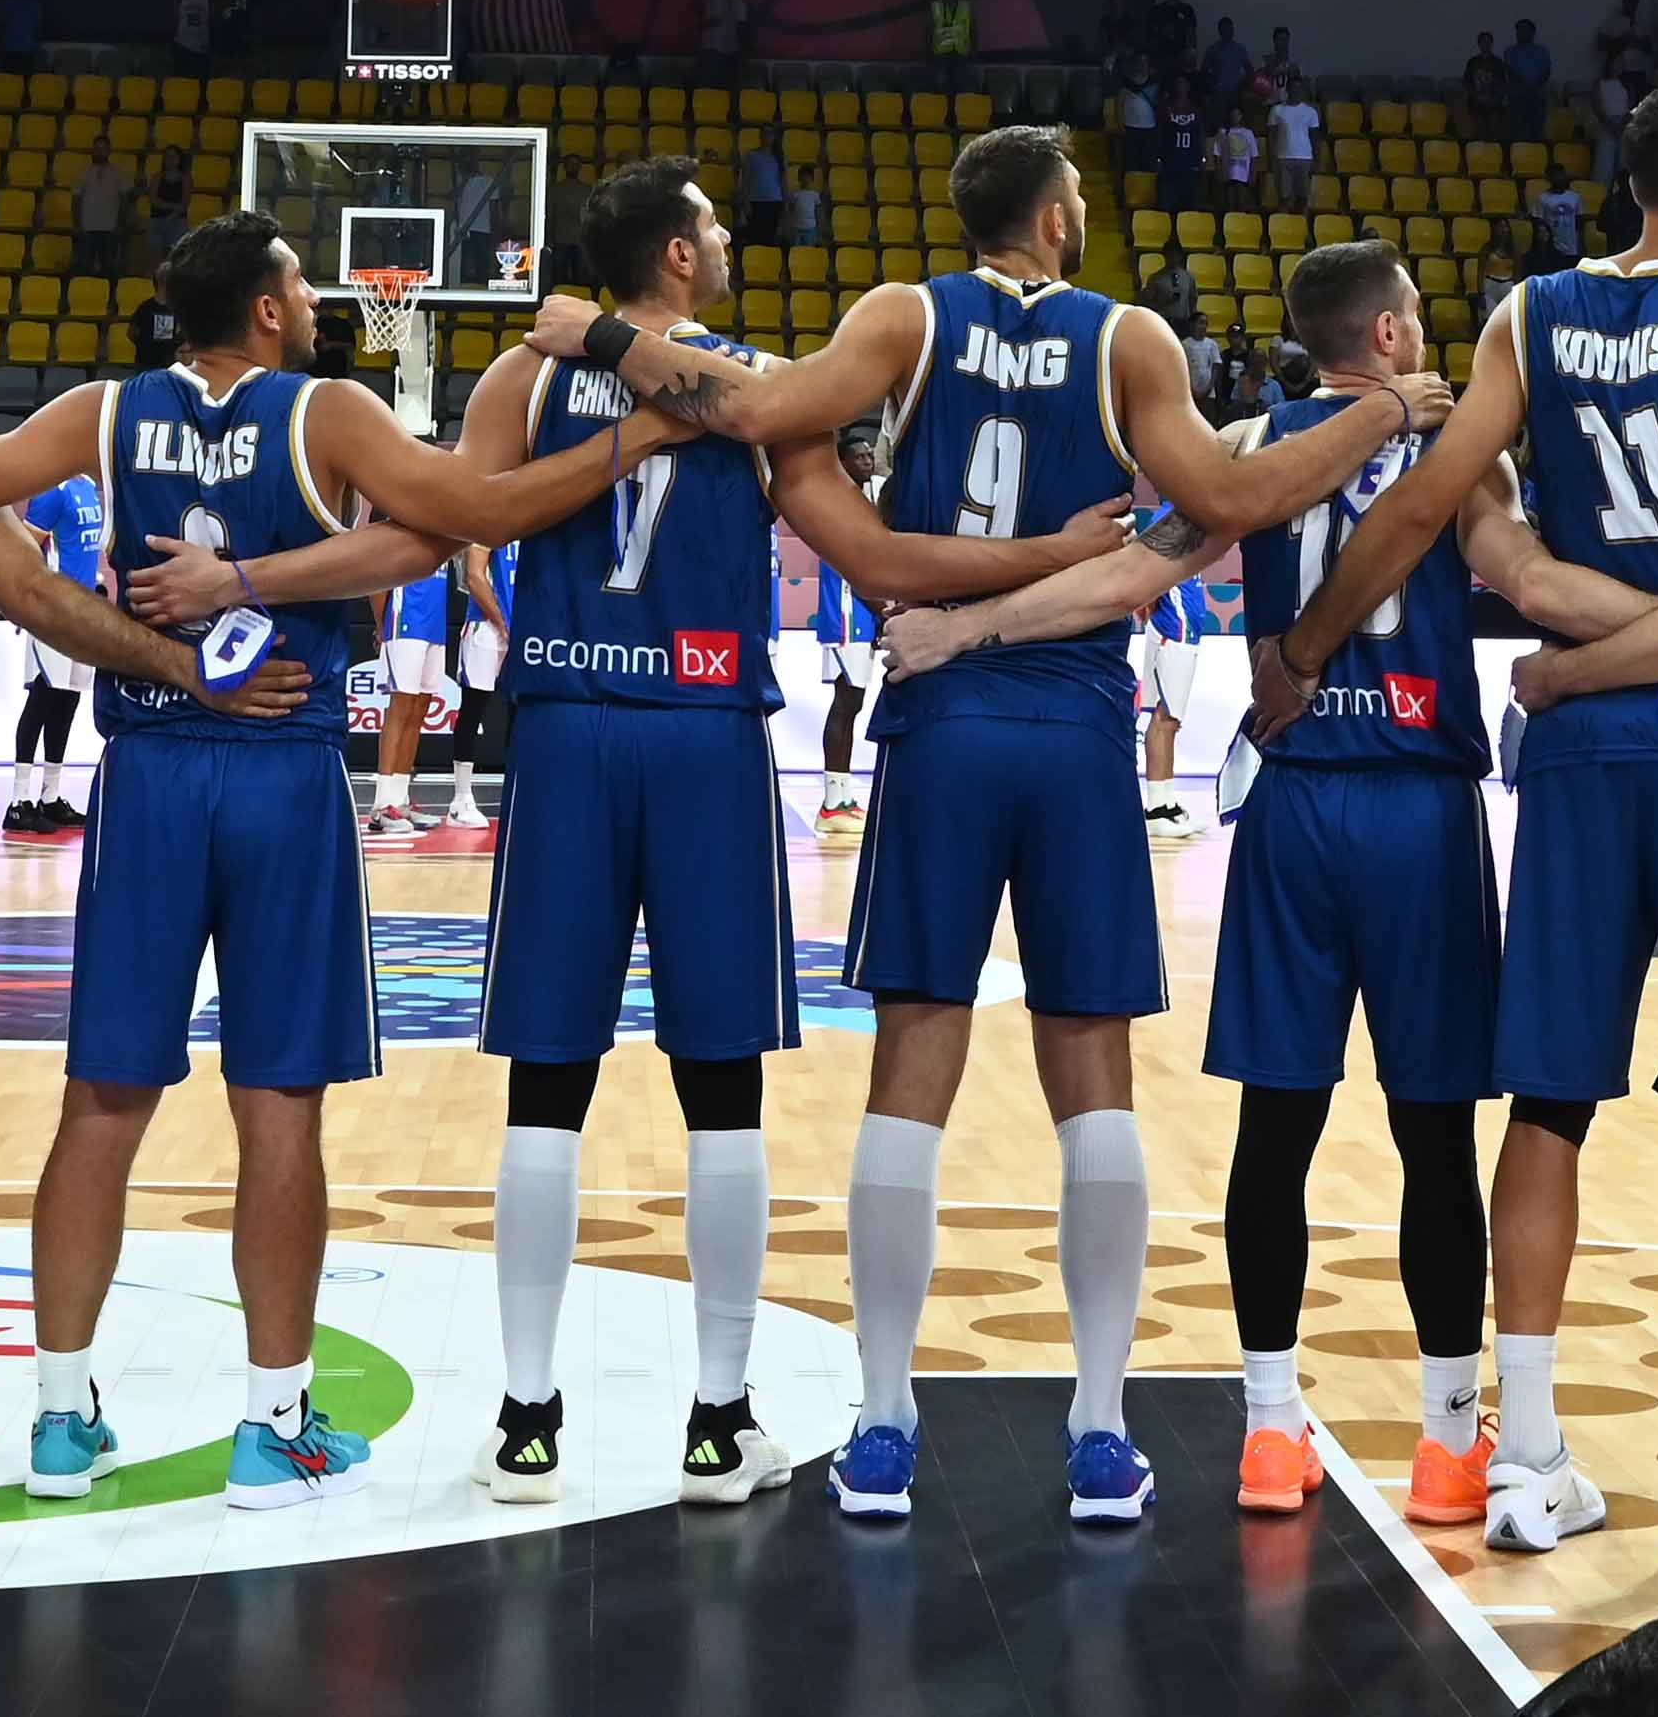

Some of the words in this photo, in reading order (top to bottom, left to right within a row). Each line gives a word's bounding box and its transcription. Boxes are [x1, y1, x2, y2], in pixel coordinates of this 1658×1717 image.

[375, 63, 453, 81] TISSOT
[1176, 131, 1191, 149] 10
[953, 321, 1071, 392] JUNG
[954, 414, 1029, 540] 9
[599, 449, 678, 596] 7
